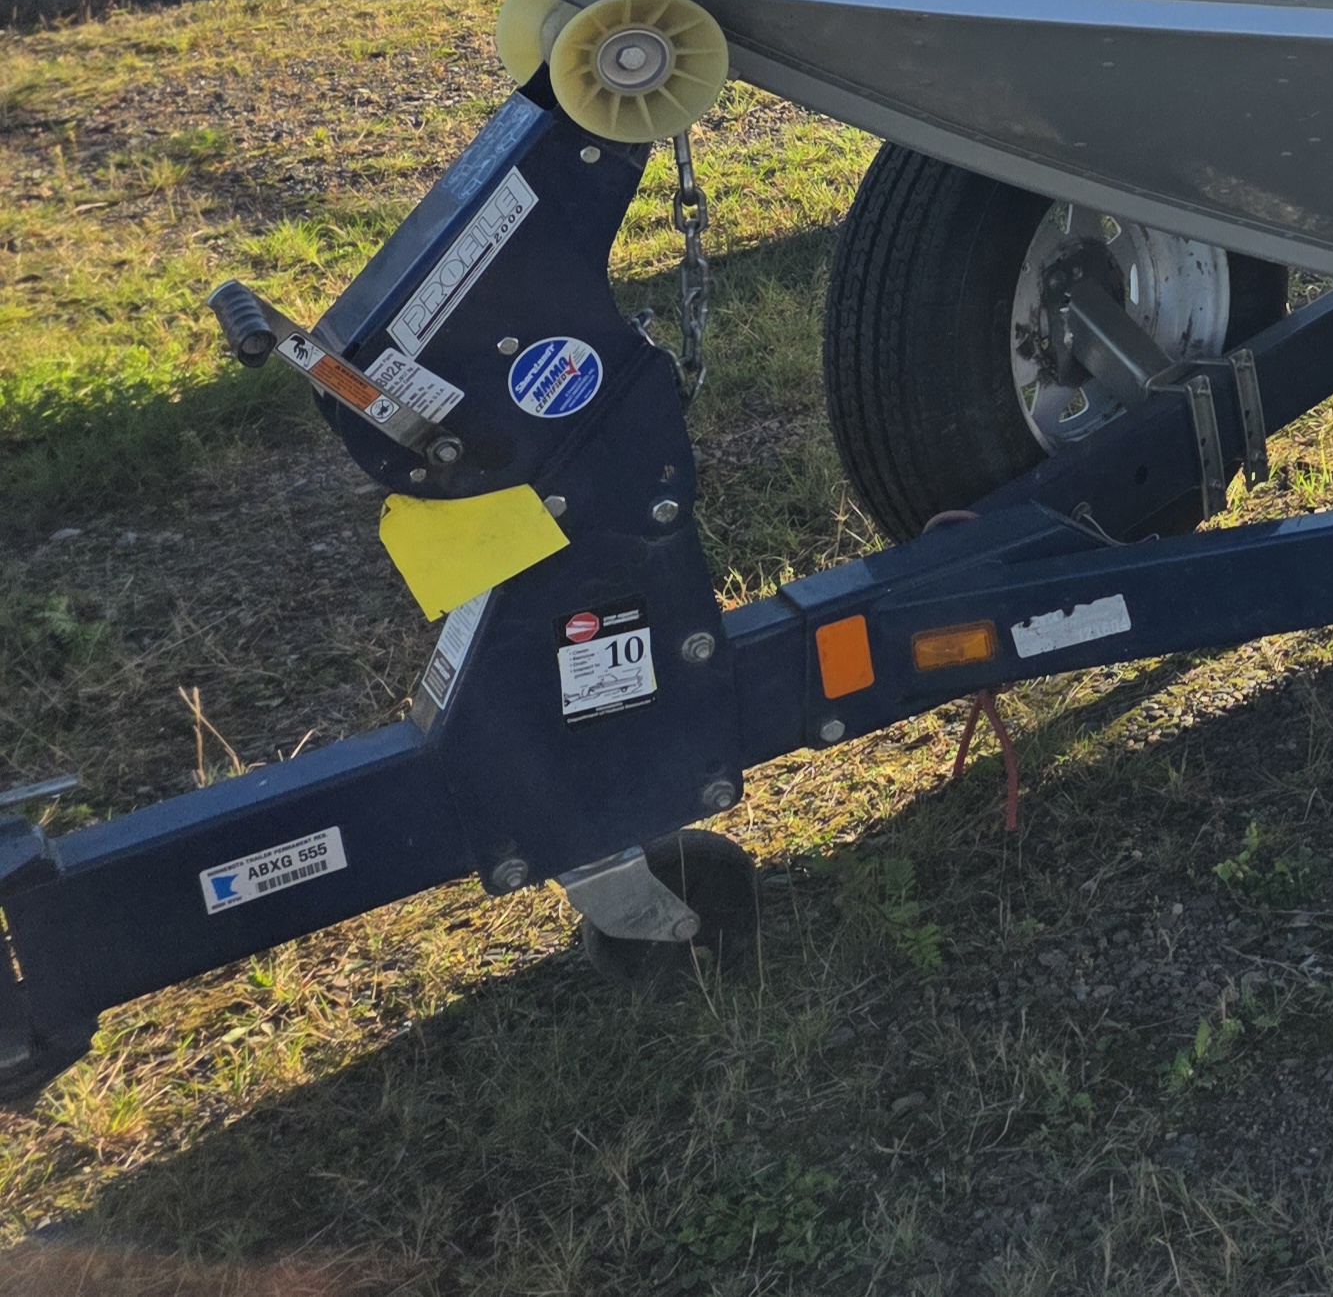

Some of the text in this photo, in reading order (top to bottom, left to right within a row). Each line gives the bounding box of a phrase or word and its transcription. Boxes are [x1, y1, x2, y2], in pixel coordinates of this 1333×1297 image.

[493, 204, 523, 244] 2000
[402, 185, 519, 336] PROFILE
[532, 356, 569, 403] NMMA
[535, 372, 568, 413] CERTIFIED
[604, 635, 645, 670] 10
[246, 850, 272, 864] TRAILER
[247, 842, 328, 881] ABXG 555
